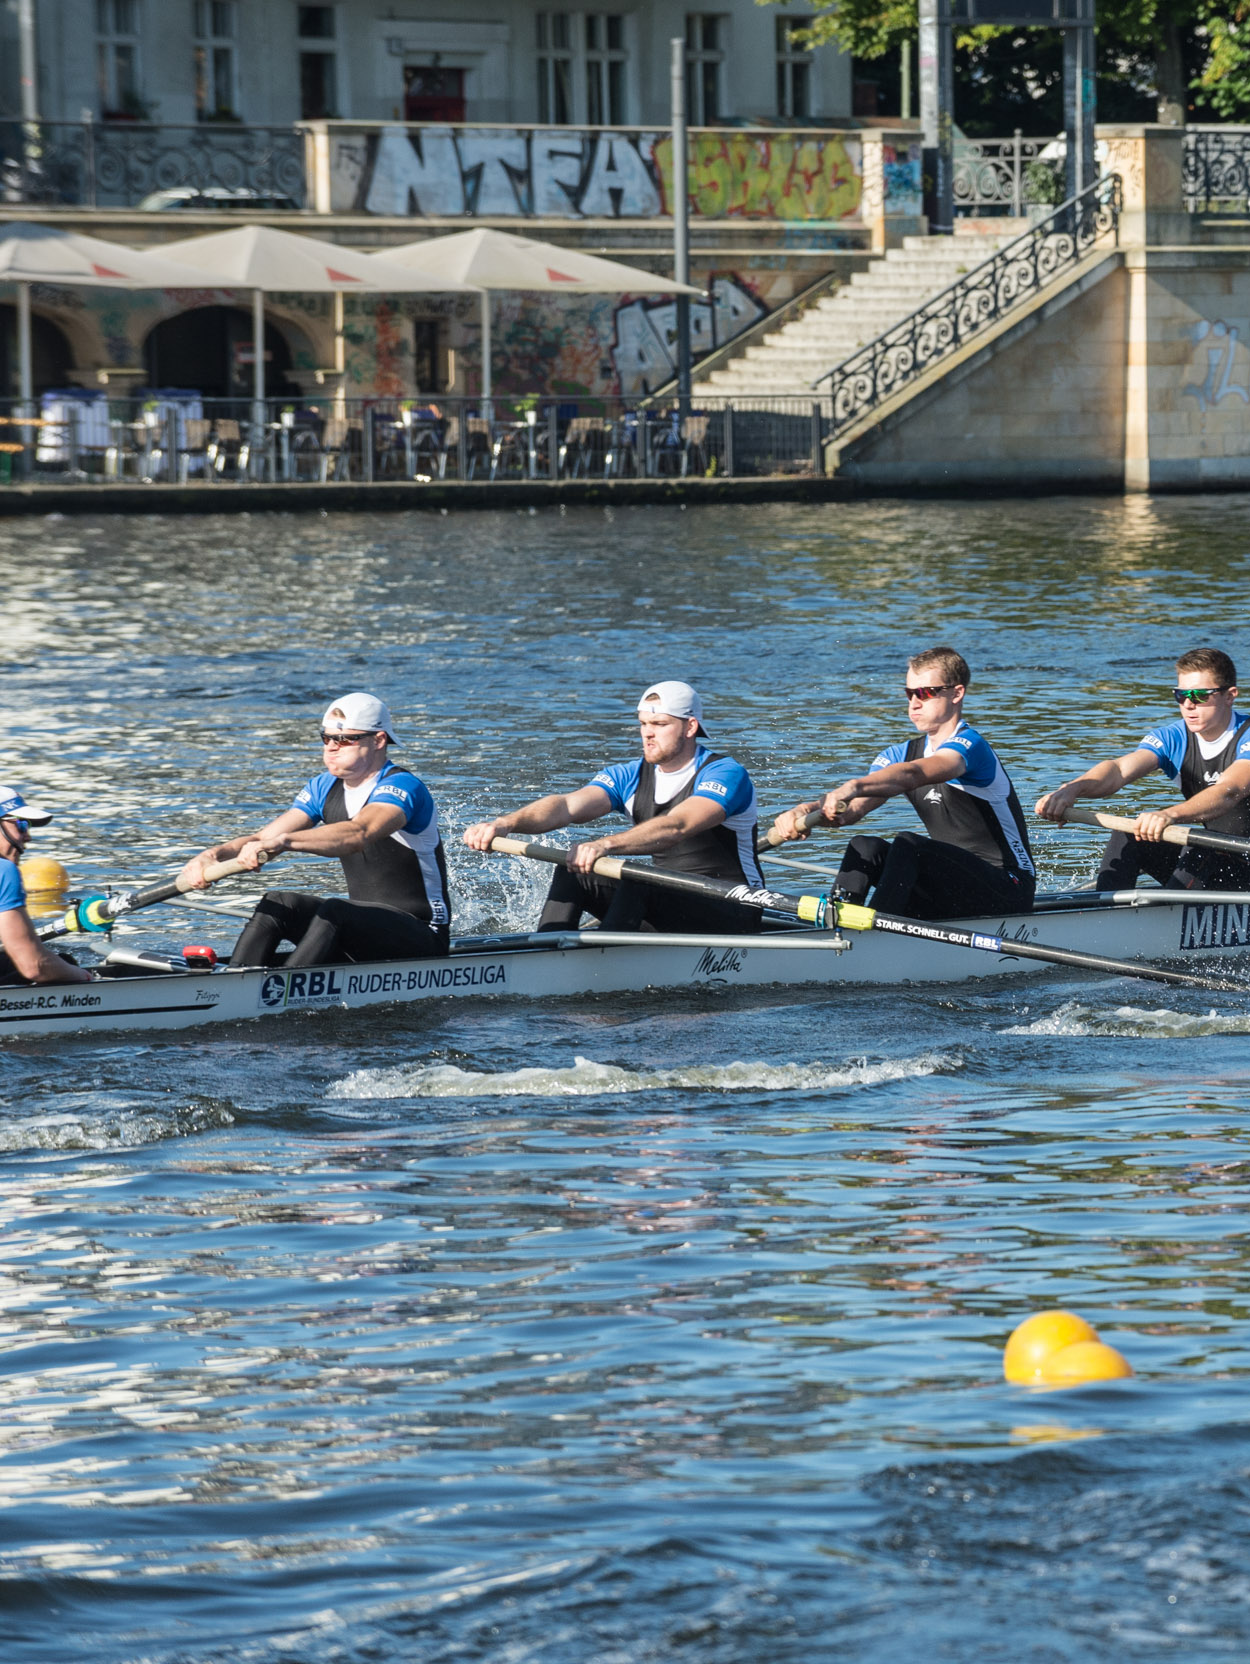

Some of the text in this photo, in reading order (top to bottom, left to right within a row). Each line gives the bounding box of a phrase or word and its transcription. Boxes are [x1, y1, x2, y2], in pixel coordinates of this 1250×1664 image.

[383, 785, 407, 800] RBL
[704, 782, 727, 795] RBL
[876, 919, 906, 933] STARK.
[907, 925, 948, 941] SCHNELL.
[948, 933, 970, 944] GUT.
[974, 935, 998, 949] RBL
[691, 947, 743, 976] Melitta
[289, 964, 506, 997] RBL RUDER-BUNDESLIGA
[0, 993, 101, 1011] Bessel-R.C. Minden
